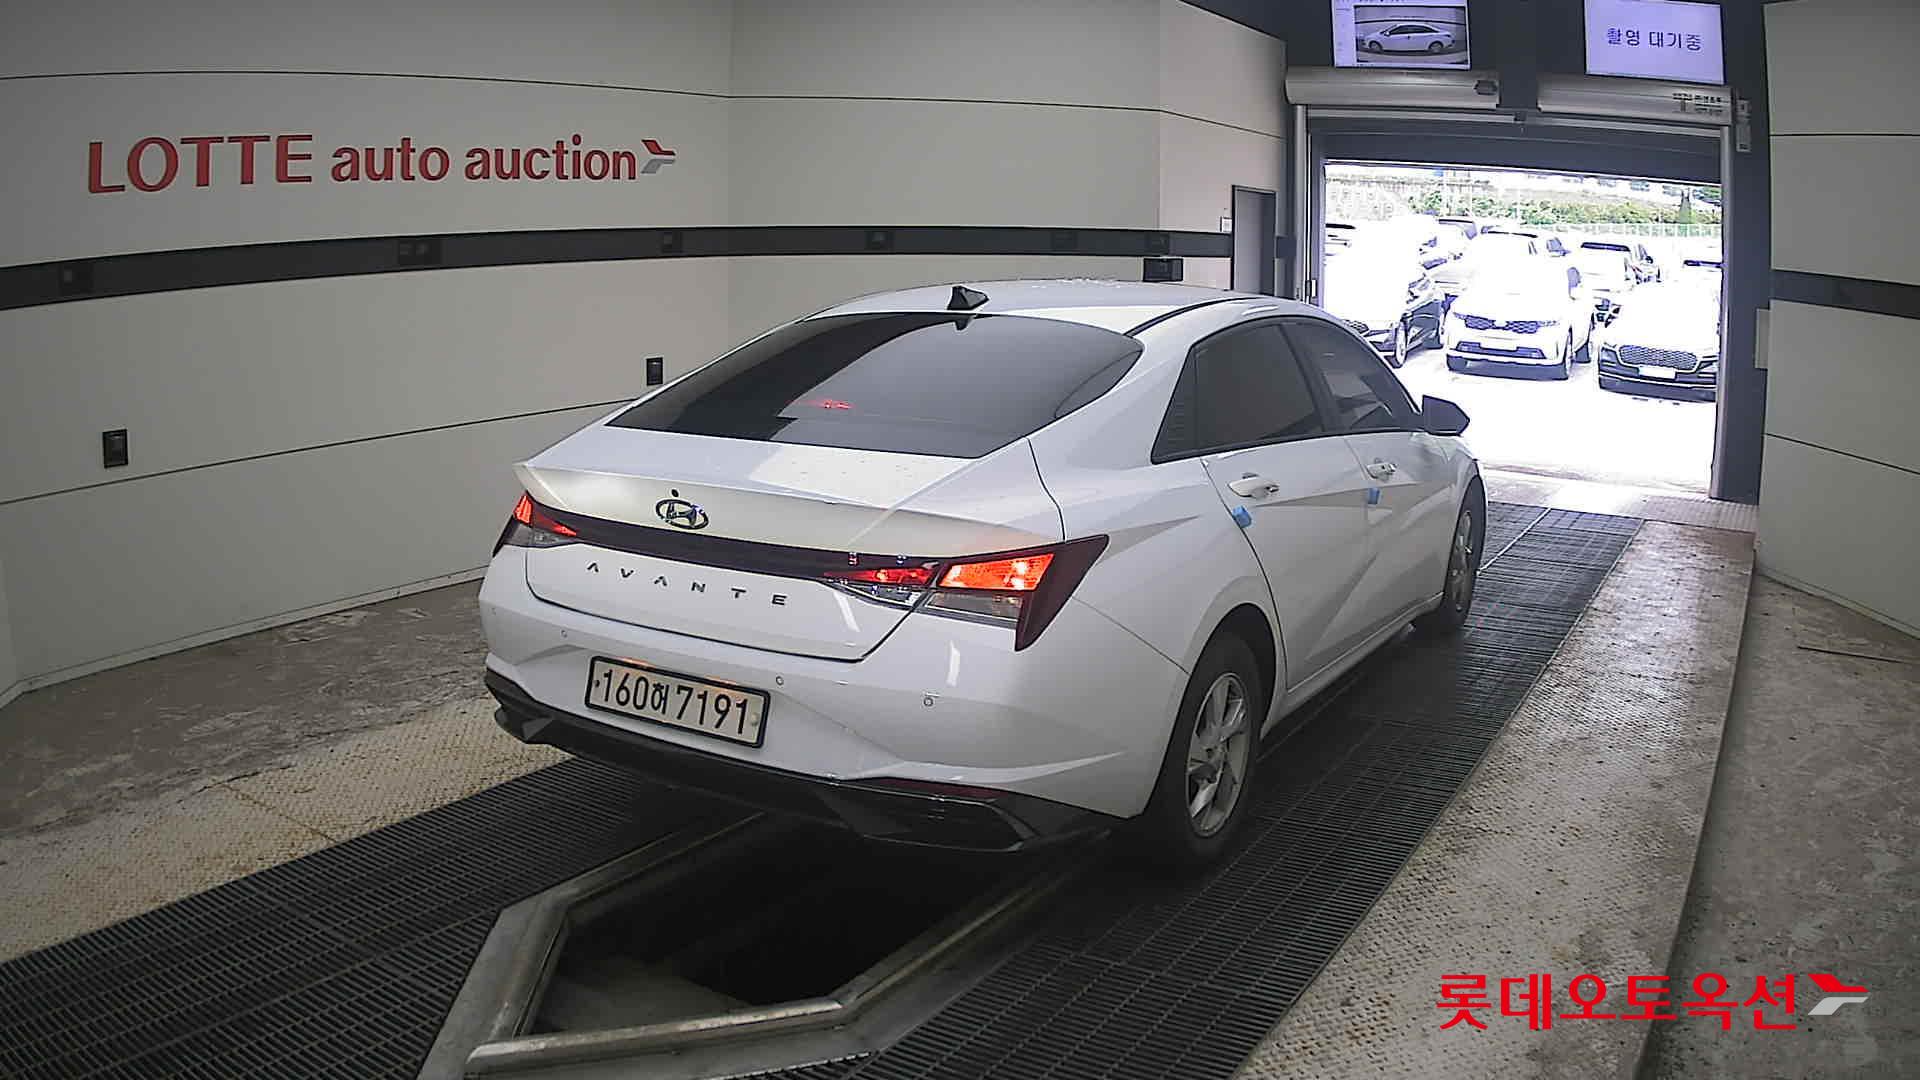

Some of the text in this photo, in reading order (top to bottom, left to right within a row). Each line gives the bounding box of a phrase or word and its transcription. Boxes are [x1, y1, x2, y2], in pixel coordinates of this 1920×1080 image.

[87, 133, 637, 194] LOTTE auto auction
[586, 561, 787, 607] AVANTE
